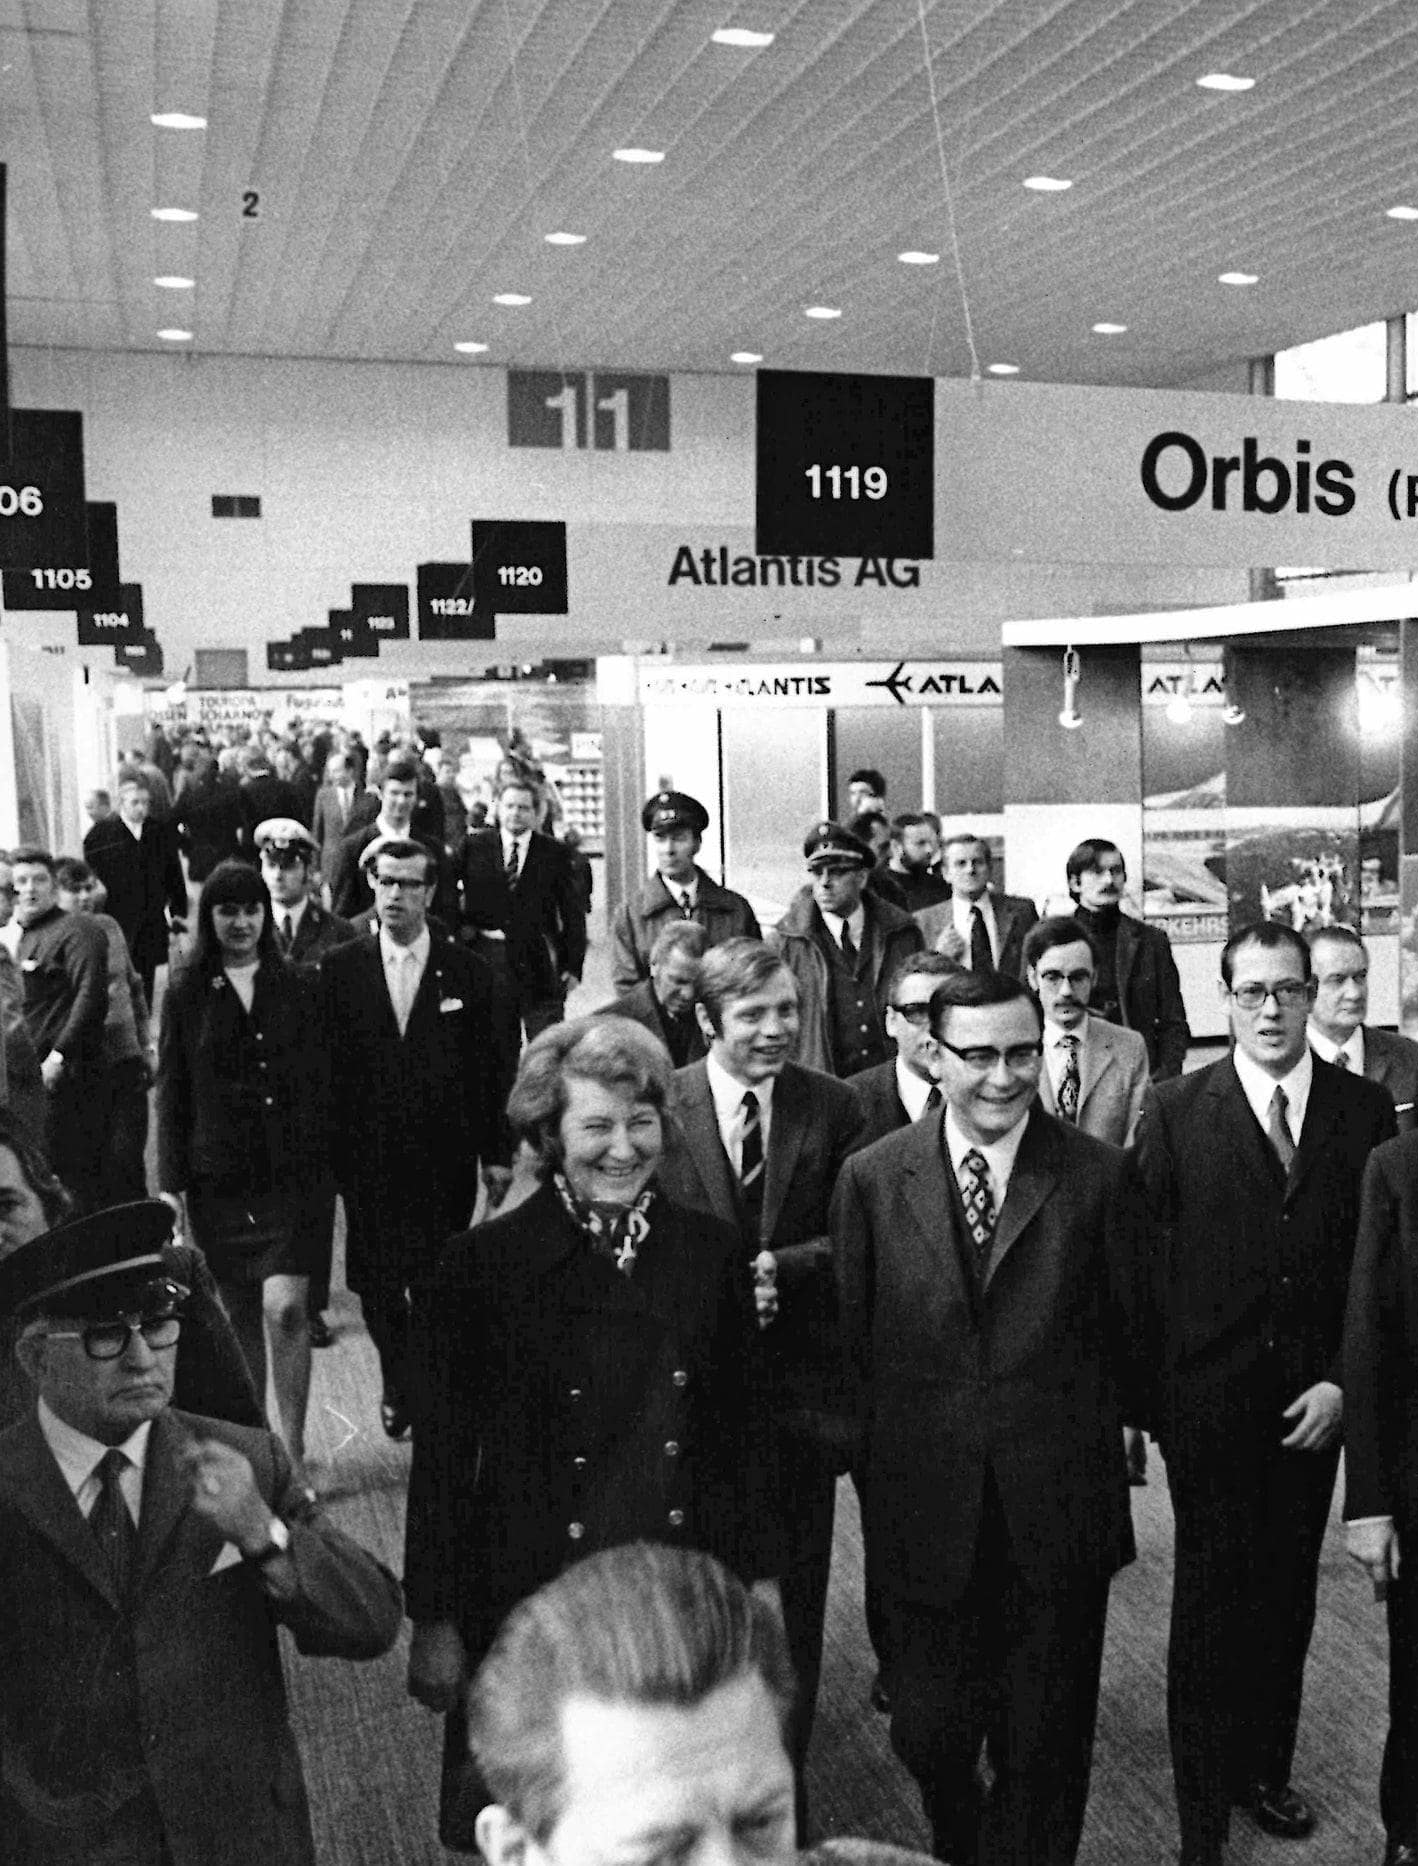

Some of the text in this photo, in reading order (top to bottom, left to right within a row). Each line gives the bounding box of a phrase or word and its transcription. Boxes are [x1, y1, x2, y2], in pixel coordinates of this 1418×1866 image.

[243, 191, 259, 218] 2
[545, 386, 629, 450] 11
[805, 464, 888, 500] 1119
[1141, 431, 1356, 516] Orbis
[0, 485, 44, 516] 06
[30, 568, 93, 590] 1105
[498, 566, 543, 586] 1120
[667, 546, 920, 587] Atlantis AG
[93, 612, 130, 628] 1104
